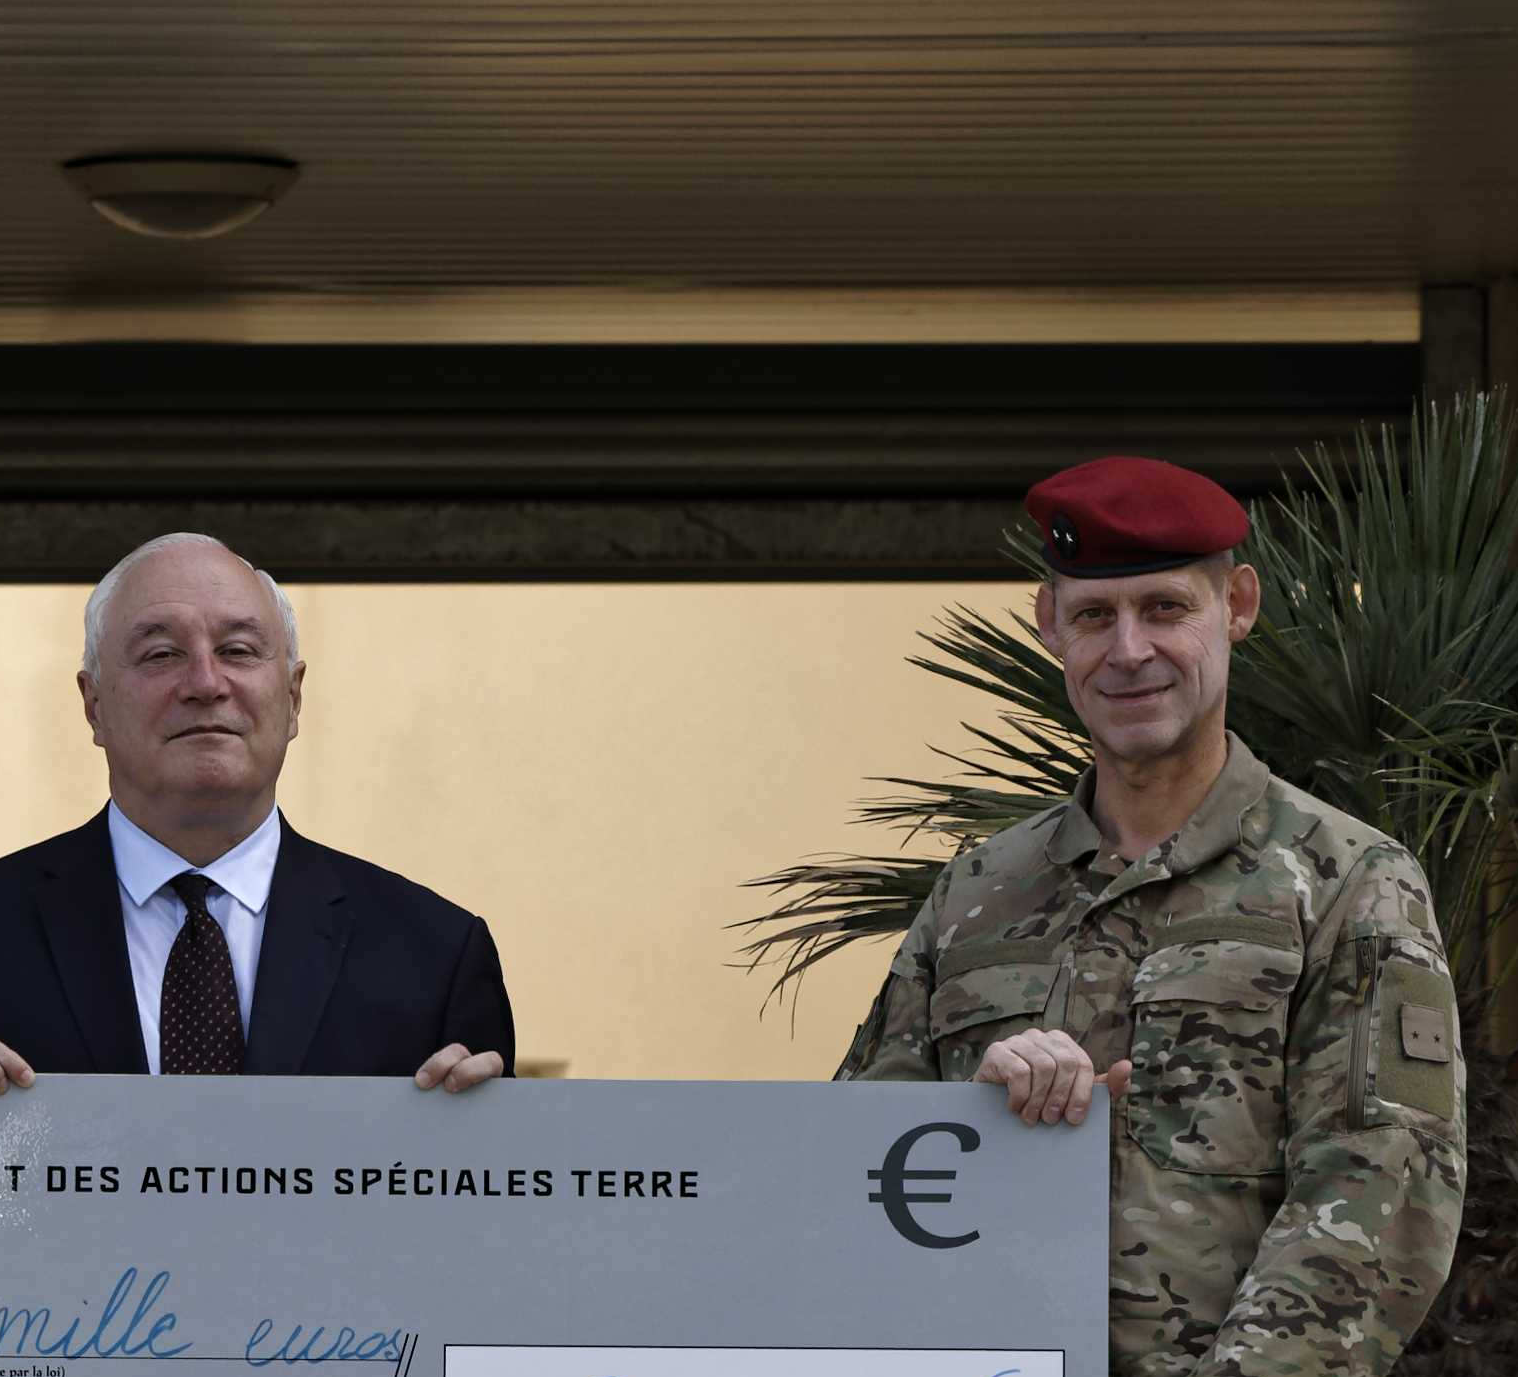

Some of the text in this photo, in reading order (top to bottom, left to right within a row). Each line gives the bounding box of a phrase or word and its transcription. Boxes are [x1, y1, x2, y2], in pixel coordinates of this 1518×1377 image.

[46, 1164, 122, 1195] DES
[139, 1165, 314, 1196] ACTIONS
[333, 1161, 554, 1197] SPÉCIALES
[571, 1169, 700, 1198] TERRE
[867, 1121, 982, 1249] €
[32, 1366, 43, 1377] la
